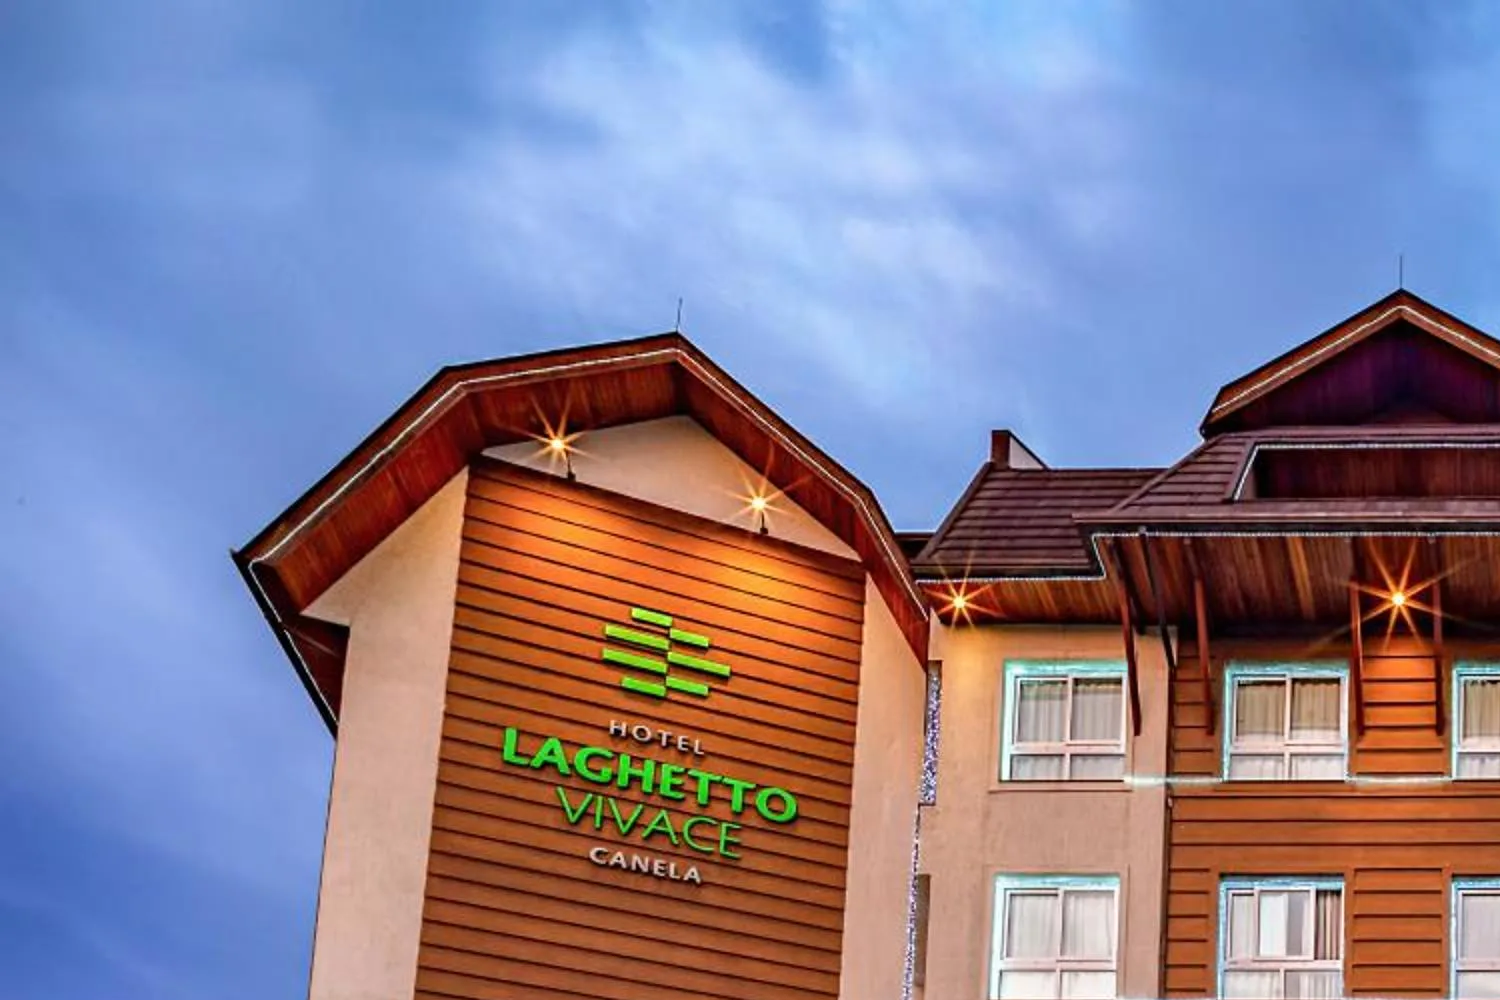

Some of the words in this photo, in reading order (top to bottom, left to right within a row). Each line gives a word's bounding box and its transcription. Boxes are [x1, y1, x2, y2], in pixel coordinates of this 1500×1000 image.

[609, 719, 705, 755] HOTEL
[502, 727, 798, 824] LAGHETTO
[556, 786, 743, 859] VIVACE
[589, 846, 702, 884] CANELA
